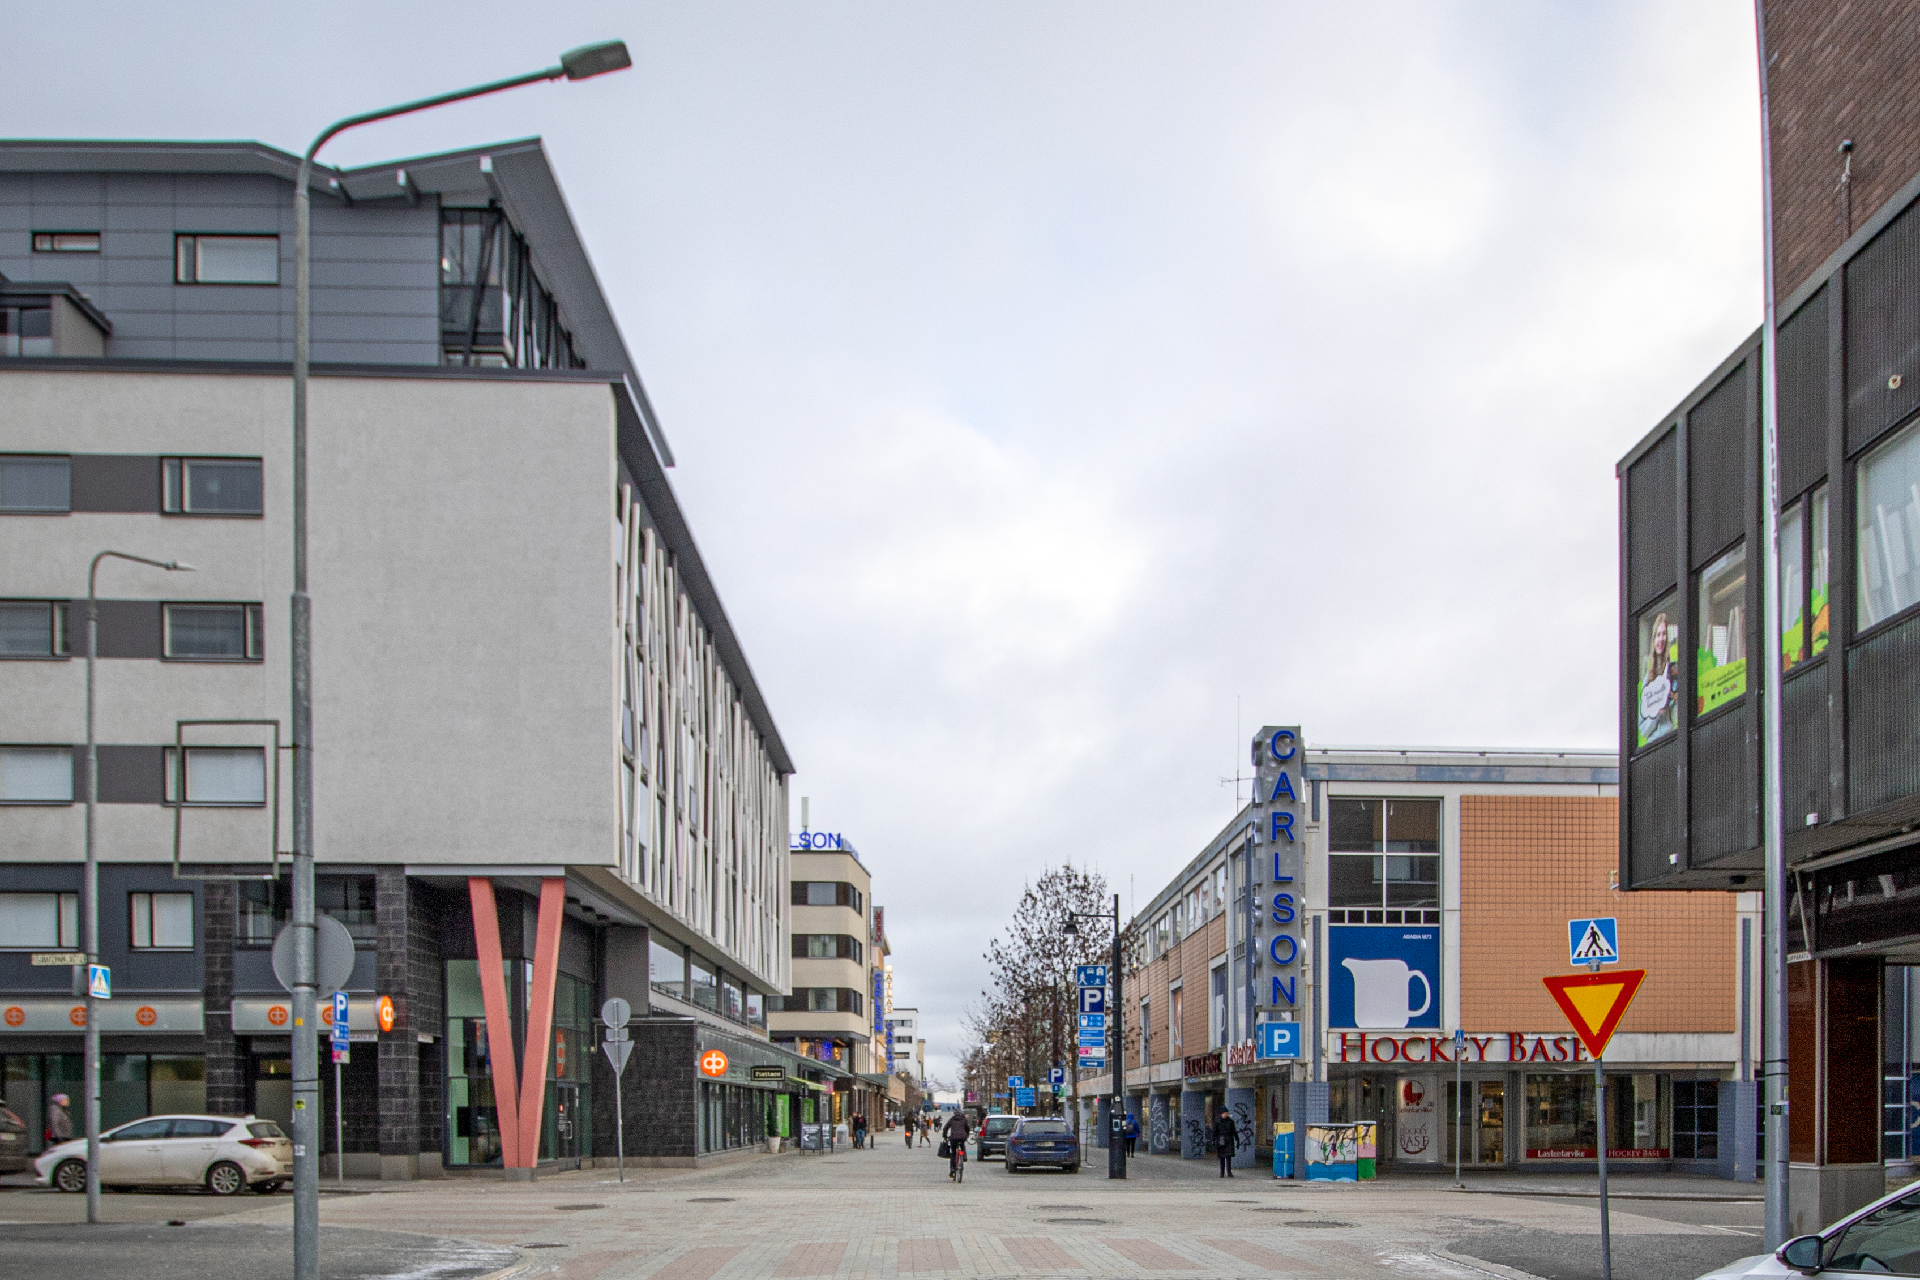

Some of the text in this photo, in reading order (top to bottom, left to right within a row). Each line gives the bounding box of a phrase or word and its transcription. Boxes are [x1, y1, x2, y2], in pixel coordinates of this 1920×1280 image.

[1270, 729, 1298, 1006] CARLSON
[874, 972, 884, 1033] CARLSON
[885, 973, 893, 1014] ATLAS
[1084, 989, 1102, 1012] P
[335, 994, 347, 1021] P
[1273, 1029, 1291, 1052] P
[1340, 1032, 1588, 1063] HOCKEY BASE
[1051, 1069, 1062, 1082] P
[1608, 1149, 1640, 1158] HOCKEY
[1642, 1149, 1660, 1158] BASE
